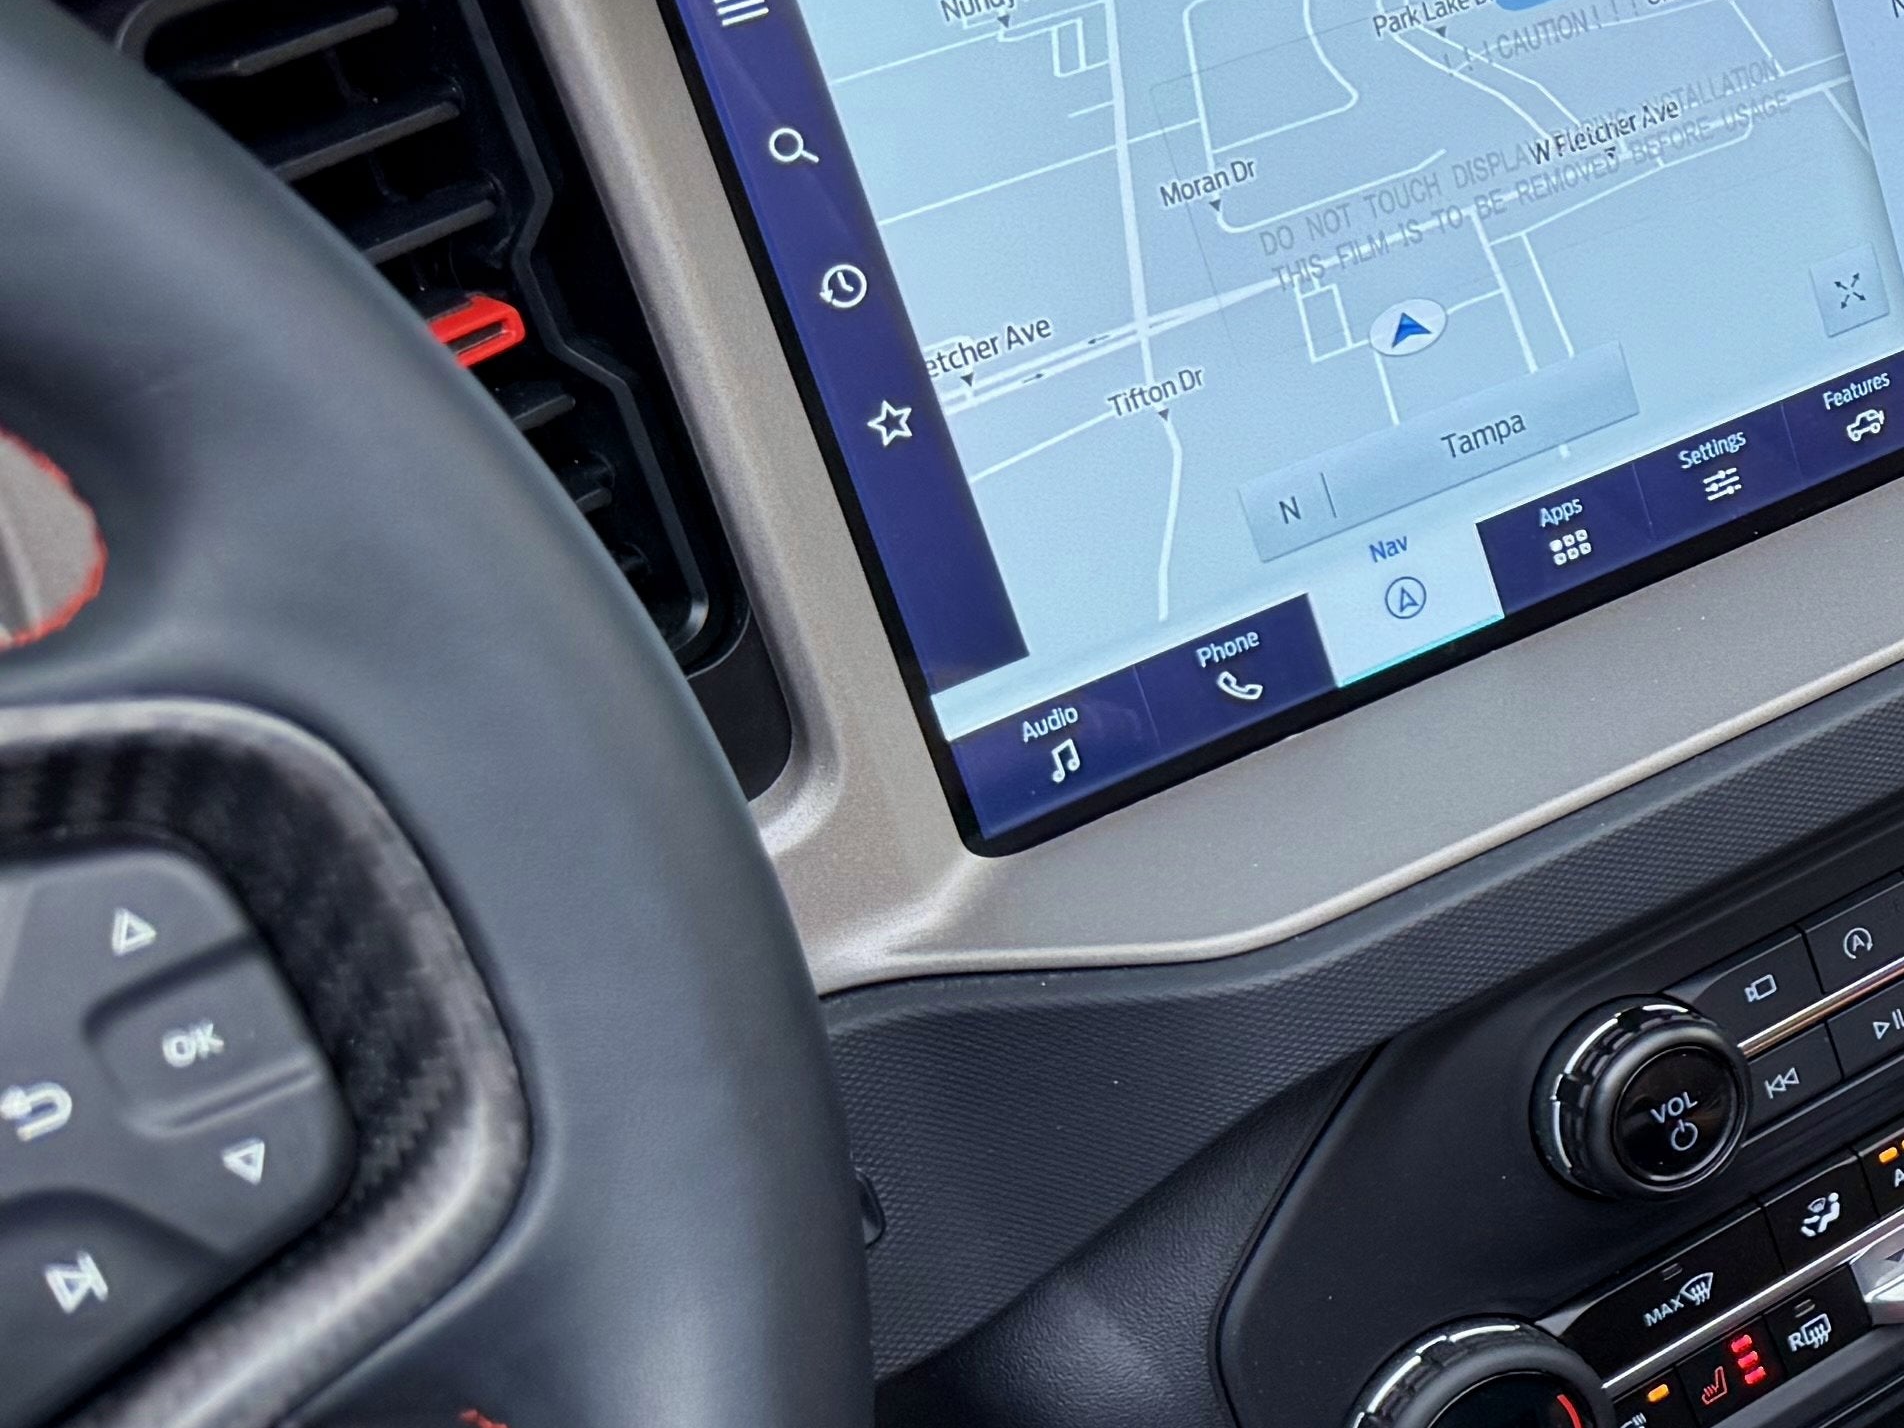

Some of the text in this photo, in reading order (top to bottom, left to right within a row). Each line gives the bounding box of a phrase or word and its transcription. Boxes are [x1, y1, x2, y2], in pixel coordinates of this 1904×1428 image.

[1373, 9, 1420, 37] Park
[1530, 100, 1680, 165] W Fletcher Ave
[1160, 158, 1256, 209] Moran Dr
[1272, 89, 1790, 292] THIS FILM IS TO BE REMOVED BEFORE USAGE
[1259, 225, 1294, 257] DO
[1305, 203, 1352, 241] NOT
[1364, 174, 1442, 220] TOUCH
[1007, 319, 1051, 351] Ave
[1108, 366, 1204, 418] Tifton Dr
[1823, 371, 1891, 411] Features
[1441, 412, 1527, 461] Tampa
[1679, 430, 1747, 472] Settings
[1279, 496, 1302, 524] N
[1539, 499, 1584, 530] Apps
[1370, 534, 1409, 564] Nav
[1198, 629, 1260, 668] Phone
[1022, 703, 1080, 744] Audio
[162, 1019, 224, 1068] OK
[1650, 1091, 1698, 1125] VOL
[1644, 1295, 1683, 1328] MAX
